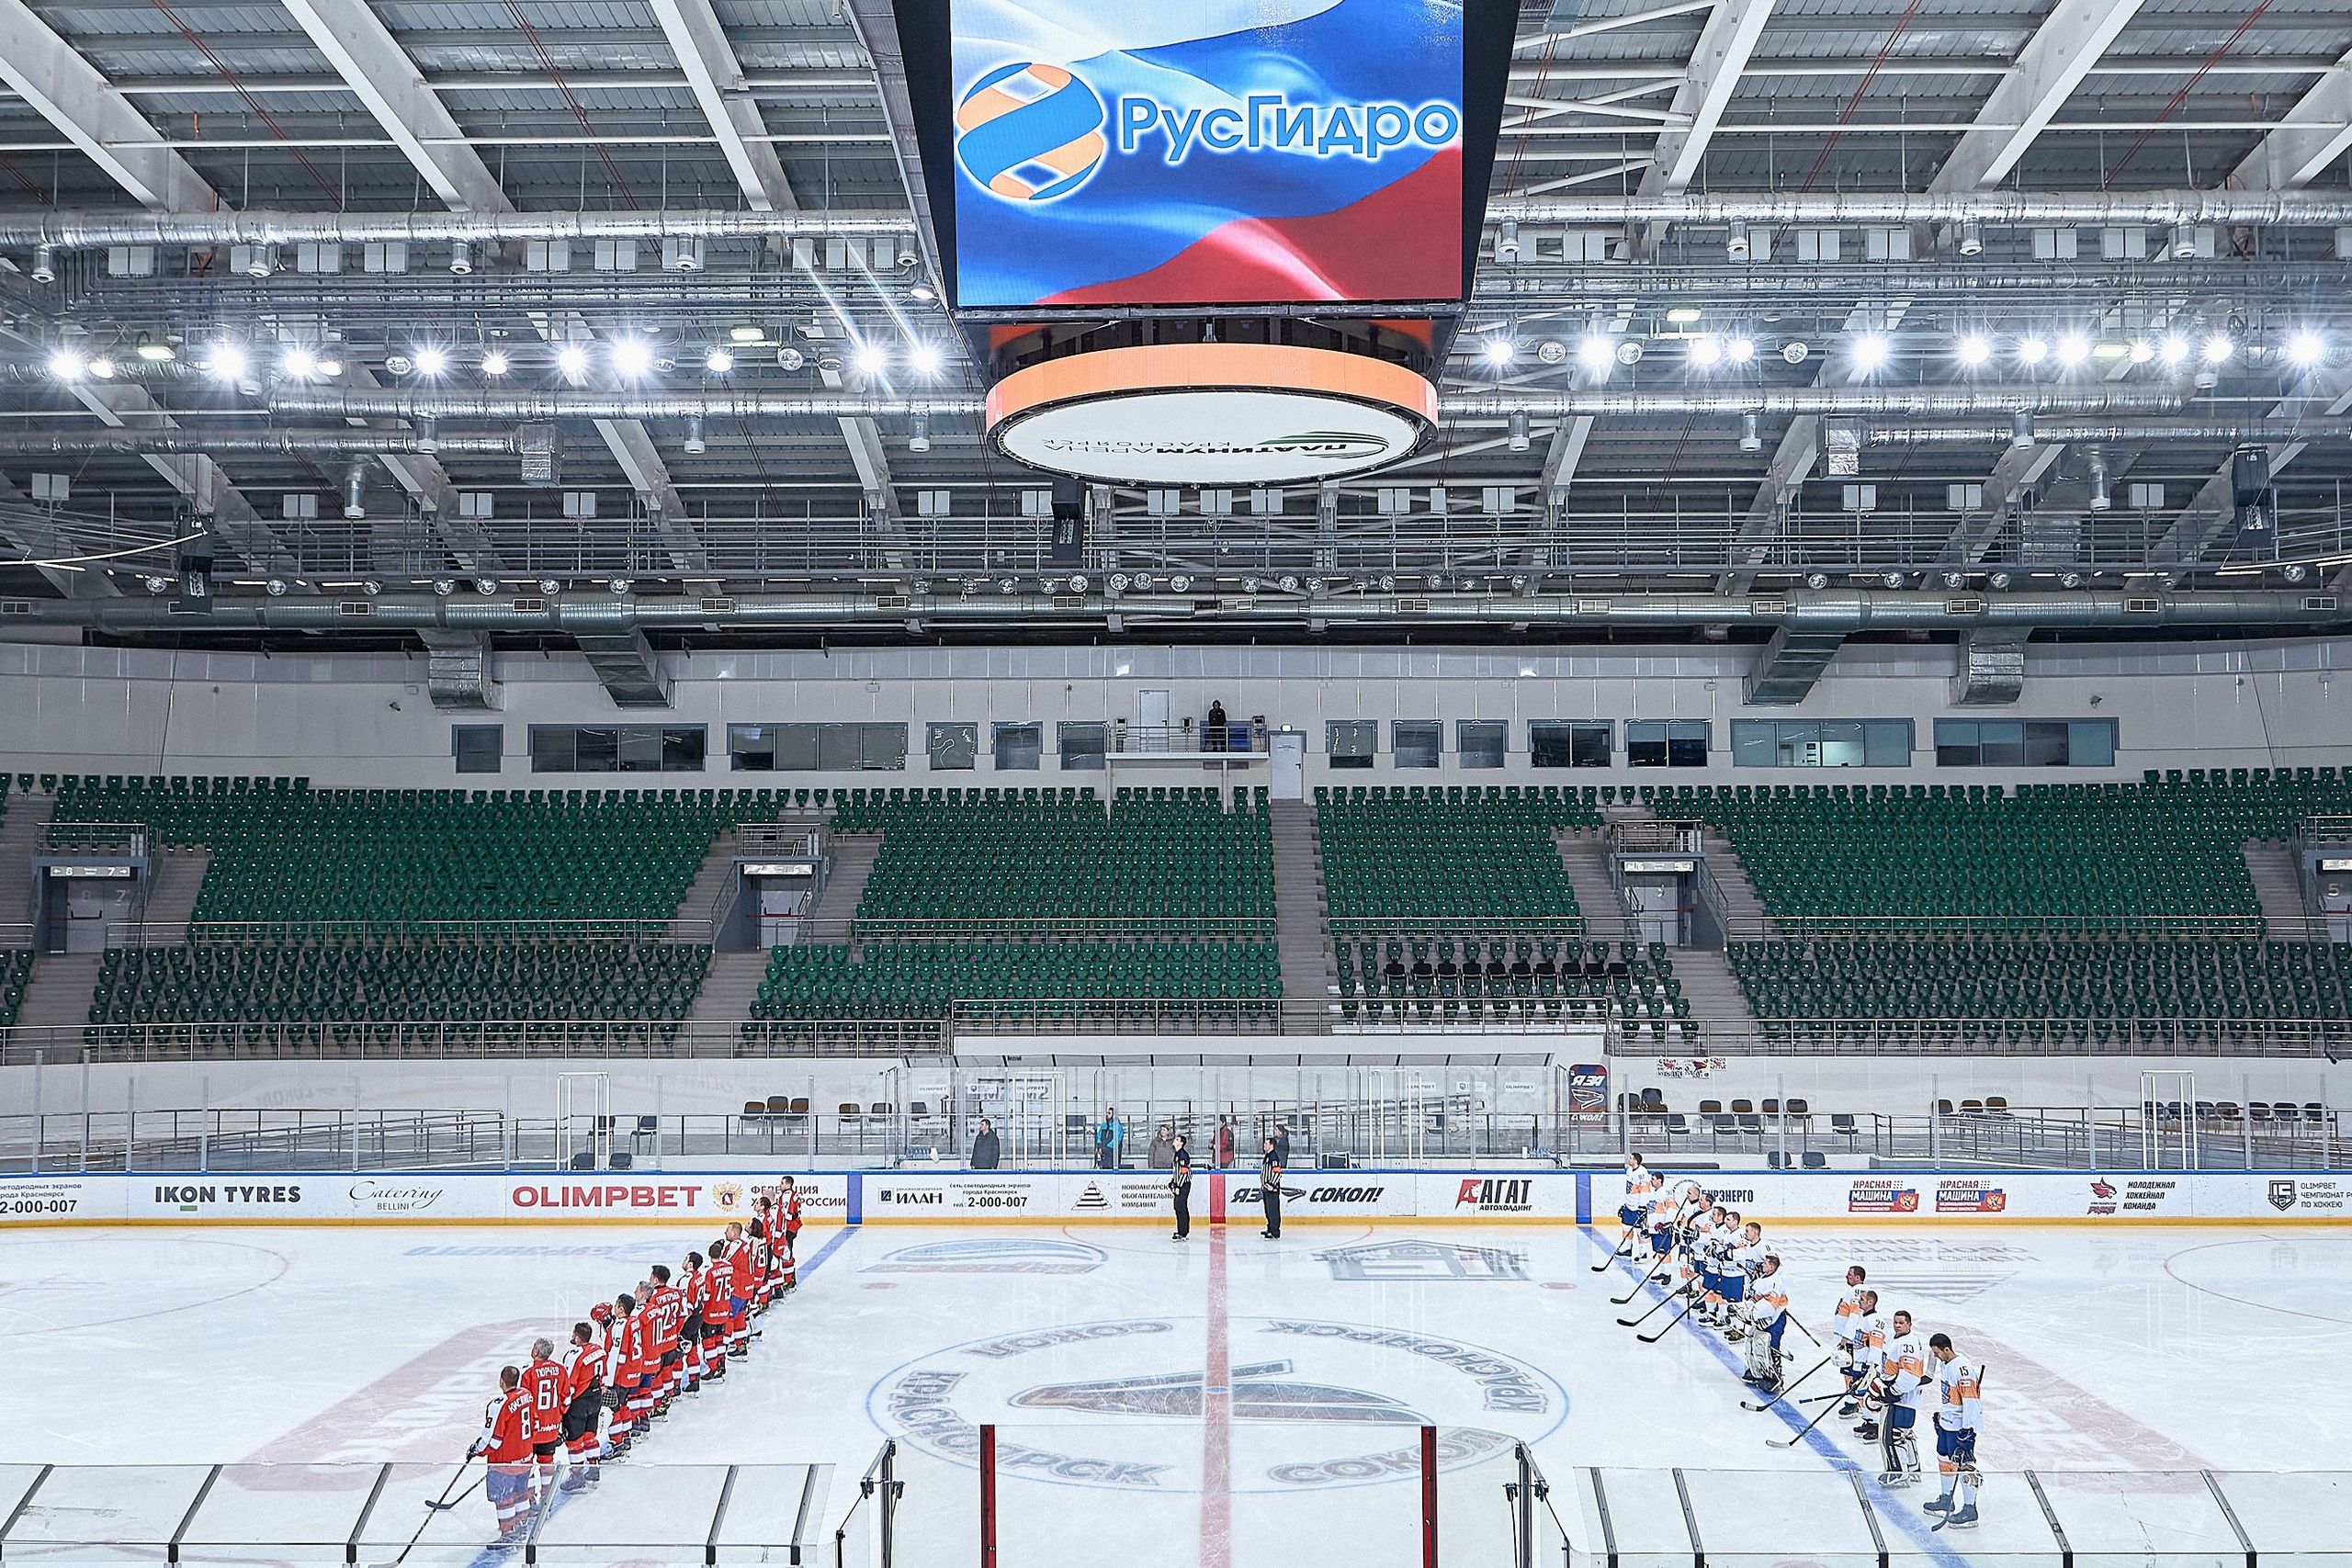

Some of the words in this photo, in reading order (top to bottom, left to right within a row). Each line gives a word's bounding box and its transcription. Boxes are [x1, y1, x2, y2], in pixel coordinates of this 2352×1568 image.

[1122, 95, 1459, 162] РусГидро
[65, 867, 74, 875] 8
[107, 867, 116, 875] 7
[1853, 1180, 1892, 1189] КРАСНАЯ
[1940, 1180, 1979, 1189] КРАСНАЯ
[155, 1186, 215, 1202] IKON
[224, 1186, 301, 1202] TYRES
[349, 1180, 445, 1209] Catering
[513, 1186, 703, 1207] OLIMPBET
[1309, 1188, 1385, 1202] СОКОЛ!
[1479, 1179, 1532, 1203] АГАТ
[1851, 1190, 1893, 1201] МАШИНА
[1939, 1190, 1980, 1201] МАШИНА
[897, 1193, 942, 1203] ИЛАН
[968, 1197, 1027, 1207] 2-000-007
[0, 1200, 77, 1213] 2-000-007
[377, 1202, 409, 1211] BELLINI
[715, 1275, 731, 1302] 75
[662, 1301, 679, 1331] 23
[1903, 1343, 1915, 1354] 33
[1960, 1366, 1969, 1377] 15
[537, 1378, 559, 1410] 61
[485, 1417, 492, 1428] 8
[521, 1406, 532, 1440] 8
